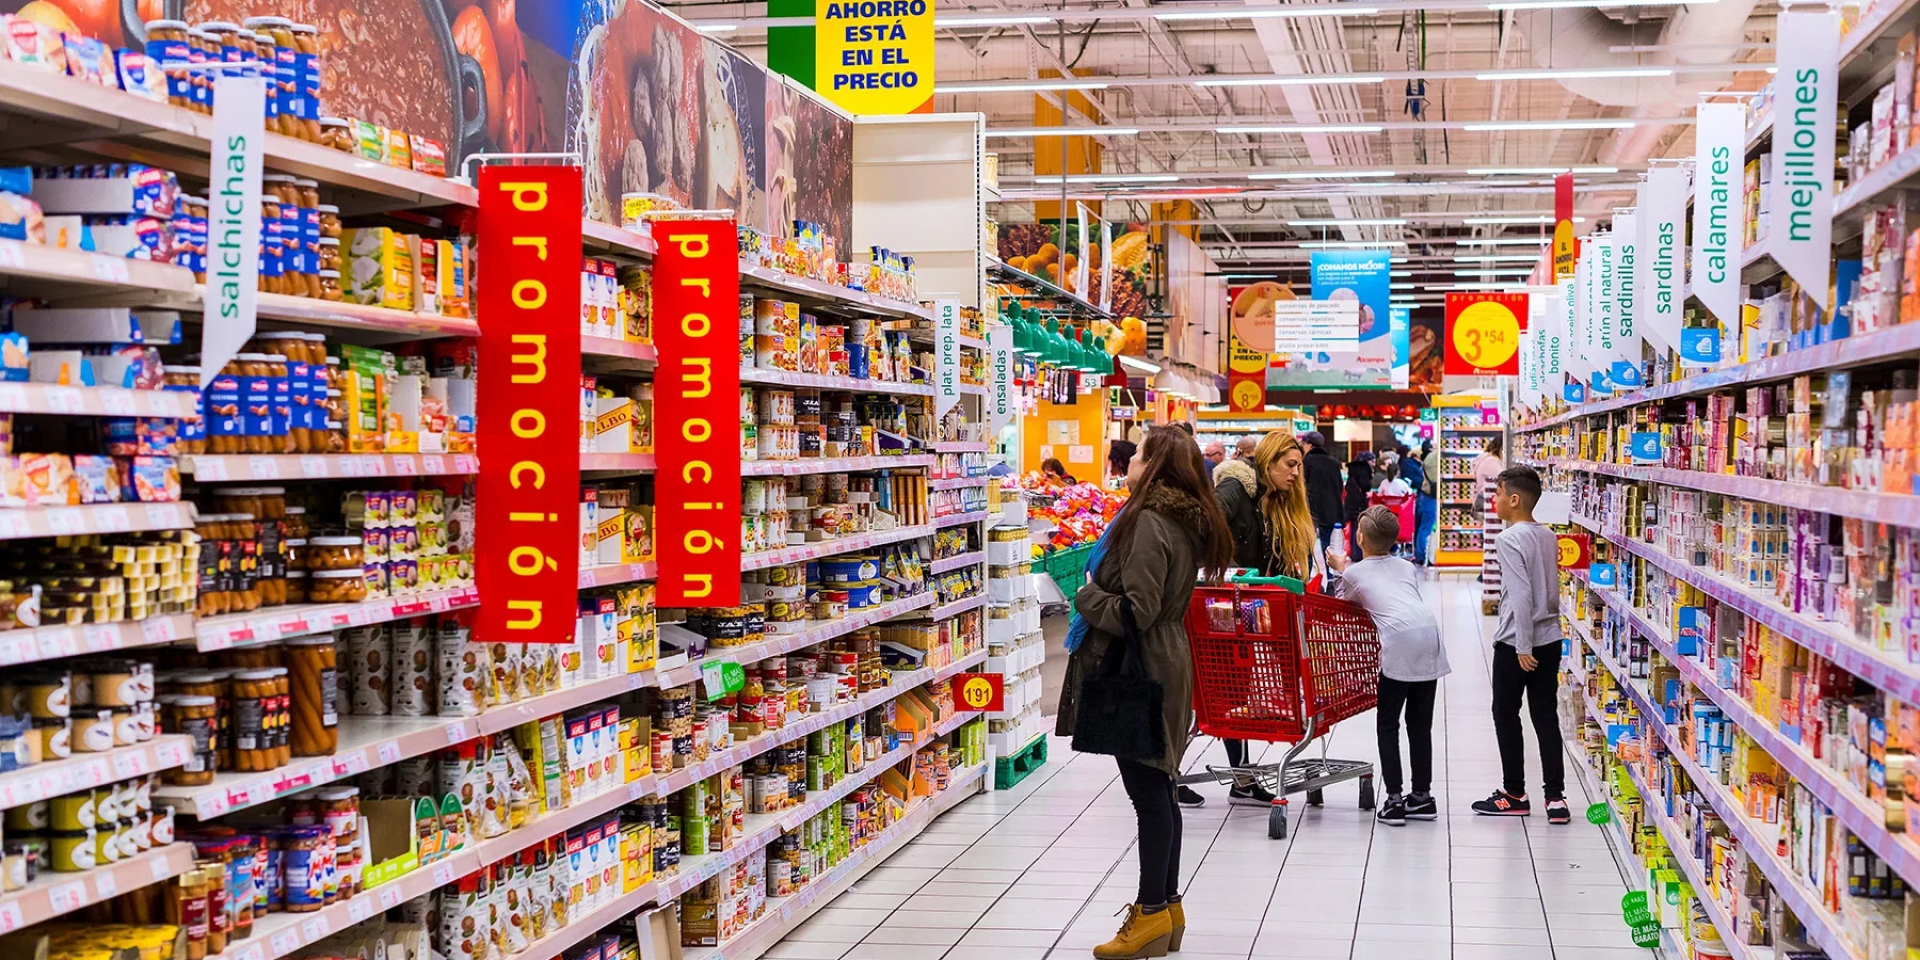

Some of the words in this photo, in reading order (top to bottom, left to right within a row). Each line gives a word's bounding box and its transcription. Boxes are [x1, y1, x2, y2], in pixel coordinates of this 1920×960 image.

[825, 0, 927, 19] AHORRO
[845, 19, 907, 42] ESTÁ
[842, 49, 874, 66] EN
[881, 48, 909, 65] EL
[833, 72, 918, 90] PRECIO
[1783, 67, 1823, 242] mejillones
[216, 134, 247, 318] salchichas
[1702, 146, 1730, 284] calamares
[1598, 245, 1612, 297] natural
[1653, 222, 1674, 314] sardinas
[1452, 294, 1524, 302] promoción
[1616, 244, 1635, 337] sardinillas
[941, 305, 953, 329] lata
[1599, 300, 1612, 313] al
[943, 332, 955, 366] prep.
[1548, 336, 1560, 374] bonito
[941, 369, 955, 396] plat.
[994, 349, 1007, 415] ensaladas
[1084, 378, 1098, 388] 53
[499, 181, 558, 630] promoción
[668, 233, 725, 598] promoción
[1423, 411, 1437, 421] 54
[965, 687, 990, 703] 1'91
[1633, 926, 1643, 936] EL
[1634, 931, 1660, 944] BARATO
